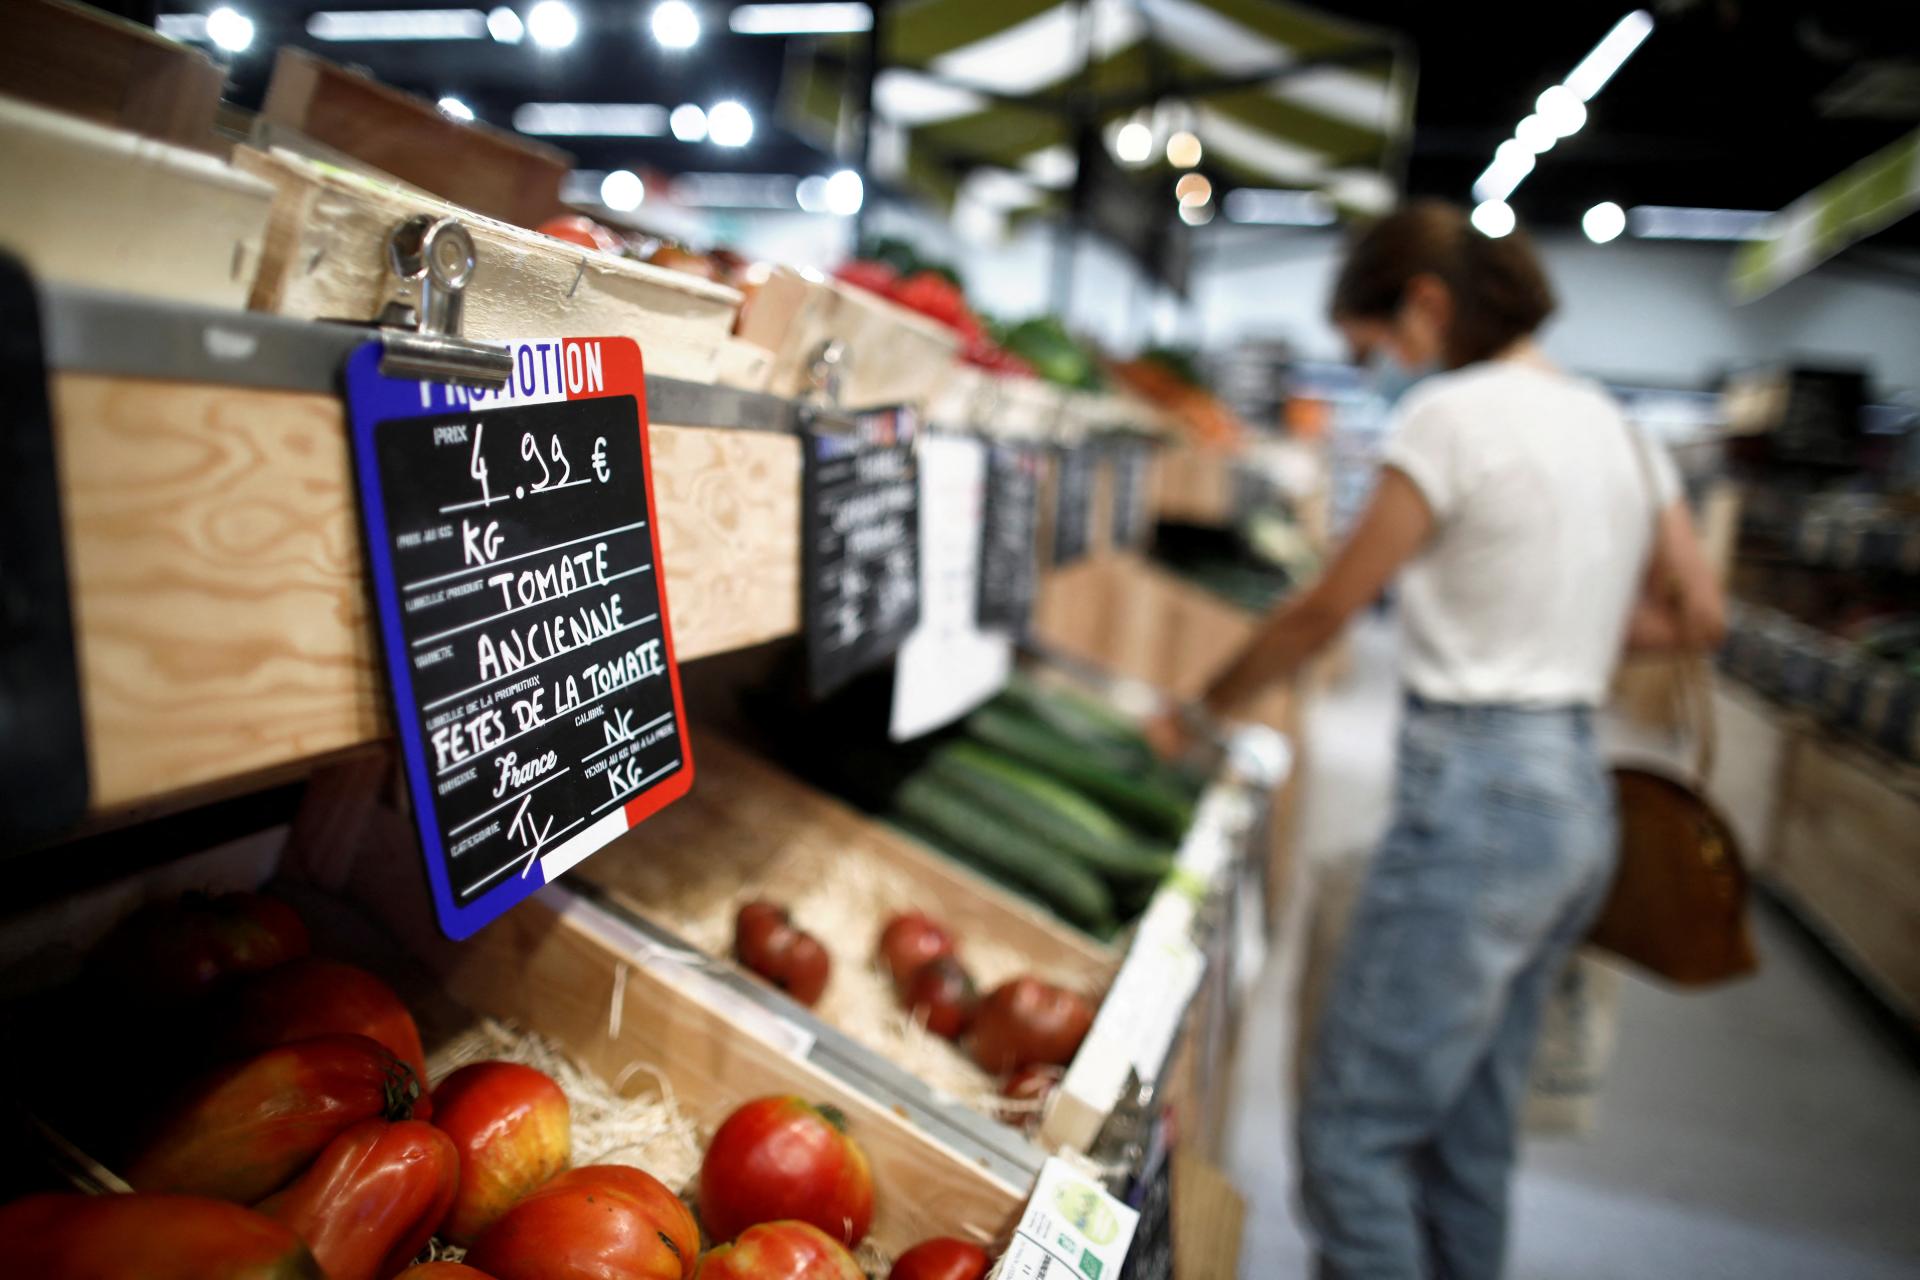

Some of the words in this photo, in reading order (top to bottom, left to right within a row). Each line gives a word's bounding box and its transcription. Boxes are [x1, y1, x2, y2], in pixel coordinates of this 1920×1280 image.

[419, 341, 605, 408] OTION
[433, 425, 468, 446] PRIX
[591, 436, 611, 483] €
[463, 519, 504, 566] KG
[446, 579, 484, 600] PRODUIT
[488, 542, 609, 611] TOMATE
[477, 593, 624, 681] ANCIENNE
[431, 710, 505, 771] FETES
[511, 687, 546, 731] DE
[555, 674, 580, 715] LA
[582, 638, 666, 698] TOMATE
[465, 700, 480, 715] DE
[479, 694, 494, 709] LA
[494, 674, 540, 702] PROMOTION
[574, 704, 605, 727] CALIBRE
[603, 707, 635, 746] NC
[492, 750, 557, 798] France
[584, 759, 609, 779] VENDU
[608, 755, 619, 768] AU
[618, 747, 630, 761] KG
[607, 756, 643, 799] KG
[451, 821, 500, 857] CATEGORIE
